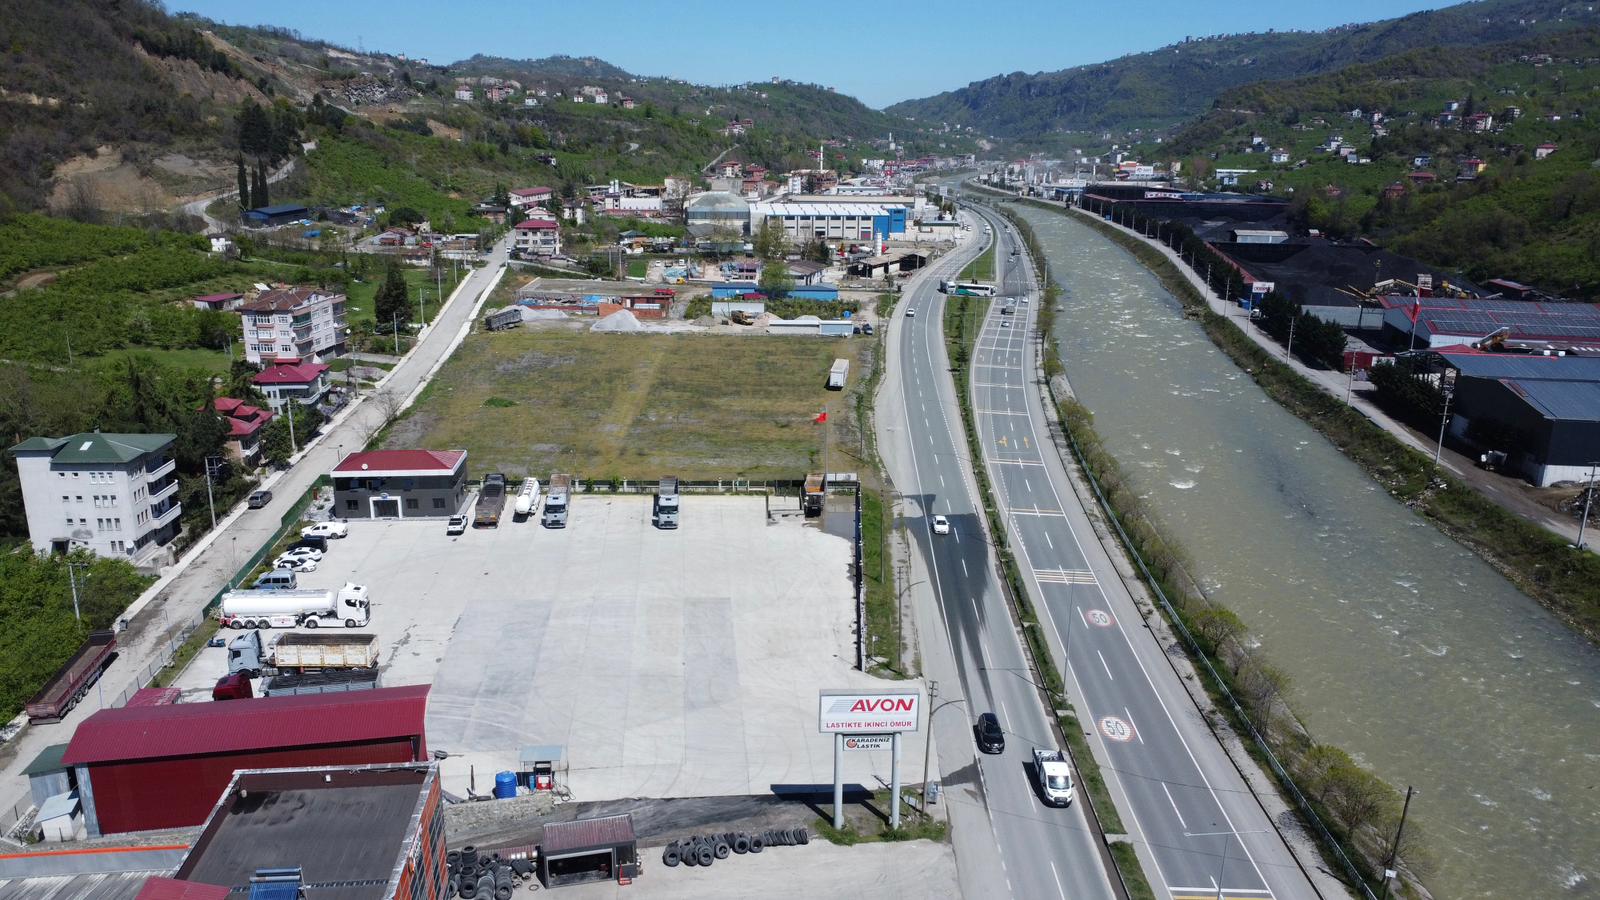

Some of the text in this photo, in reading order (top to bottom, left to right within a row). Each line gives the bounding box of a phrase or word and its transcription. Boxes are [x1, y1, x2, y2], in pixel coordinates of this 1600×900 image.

[1092, 613, 1108, 624] 50
[850, 698, 914, 712] AVON
[1105, 720, 1125, 736] 50
